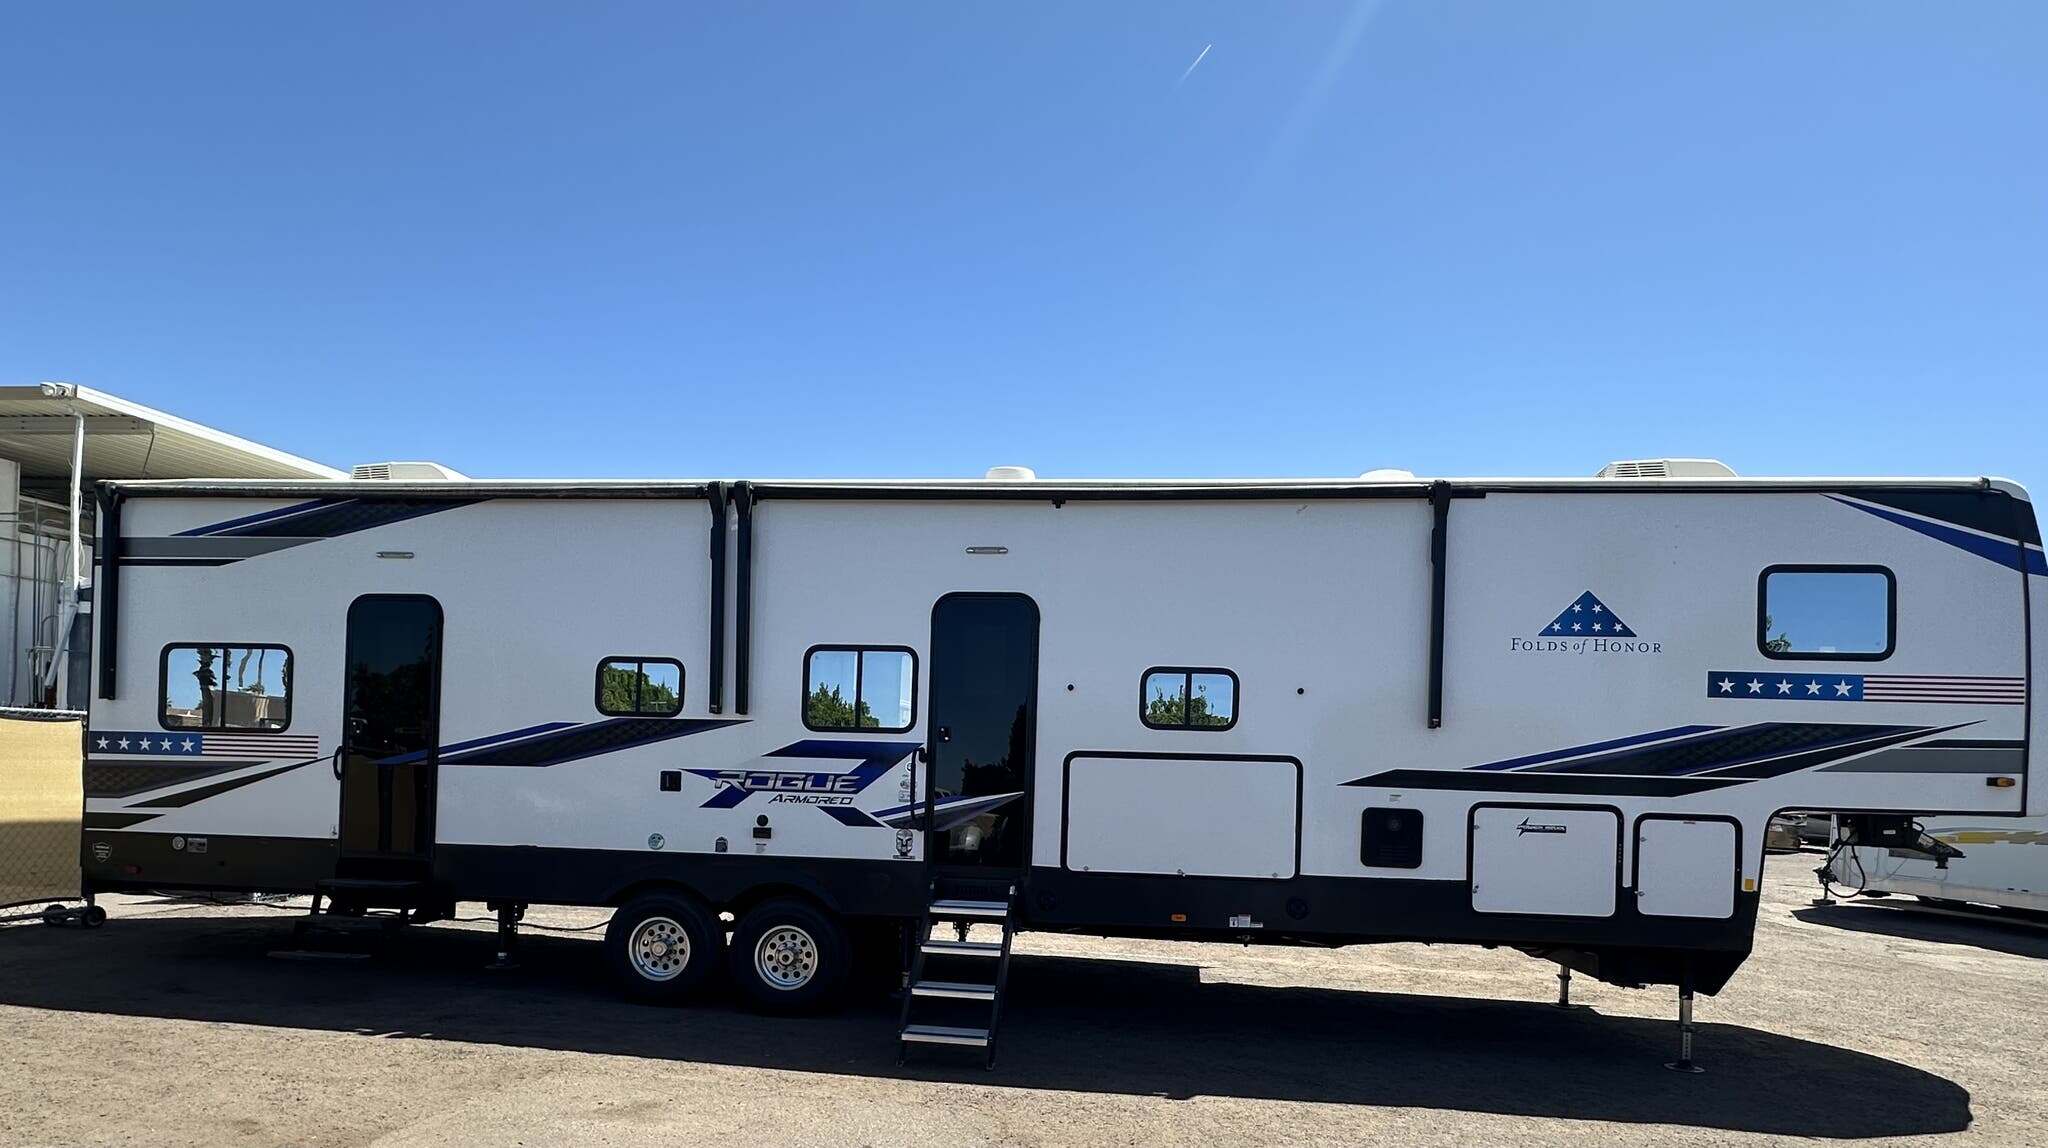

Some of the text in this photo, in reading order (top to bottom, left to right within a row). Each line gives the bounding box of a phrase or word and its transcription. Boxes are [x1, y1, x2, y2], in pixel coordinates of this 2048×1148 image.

[1510, 637, 1662, 655] FOLDS of HONOR
[711, 770, 861, 793] ROGUE
[767, 793, 854, 805] ARMORED
